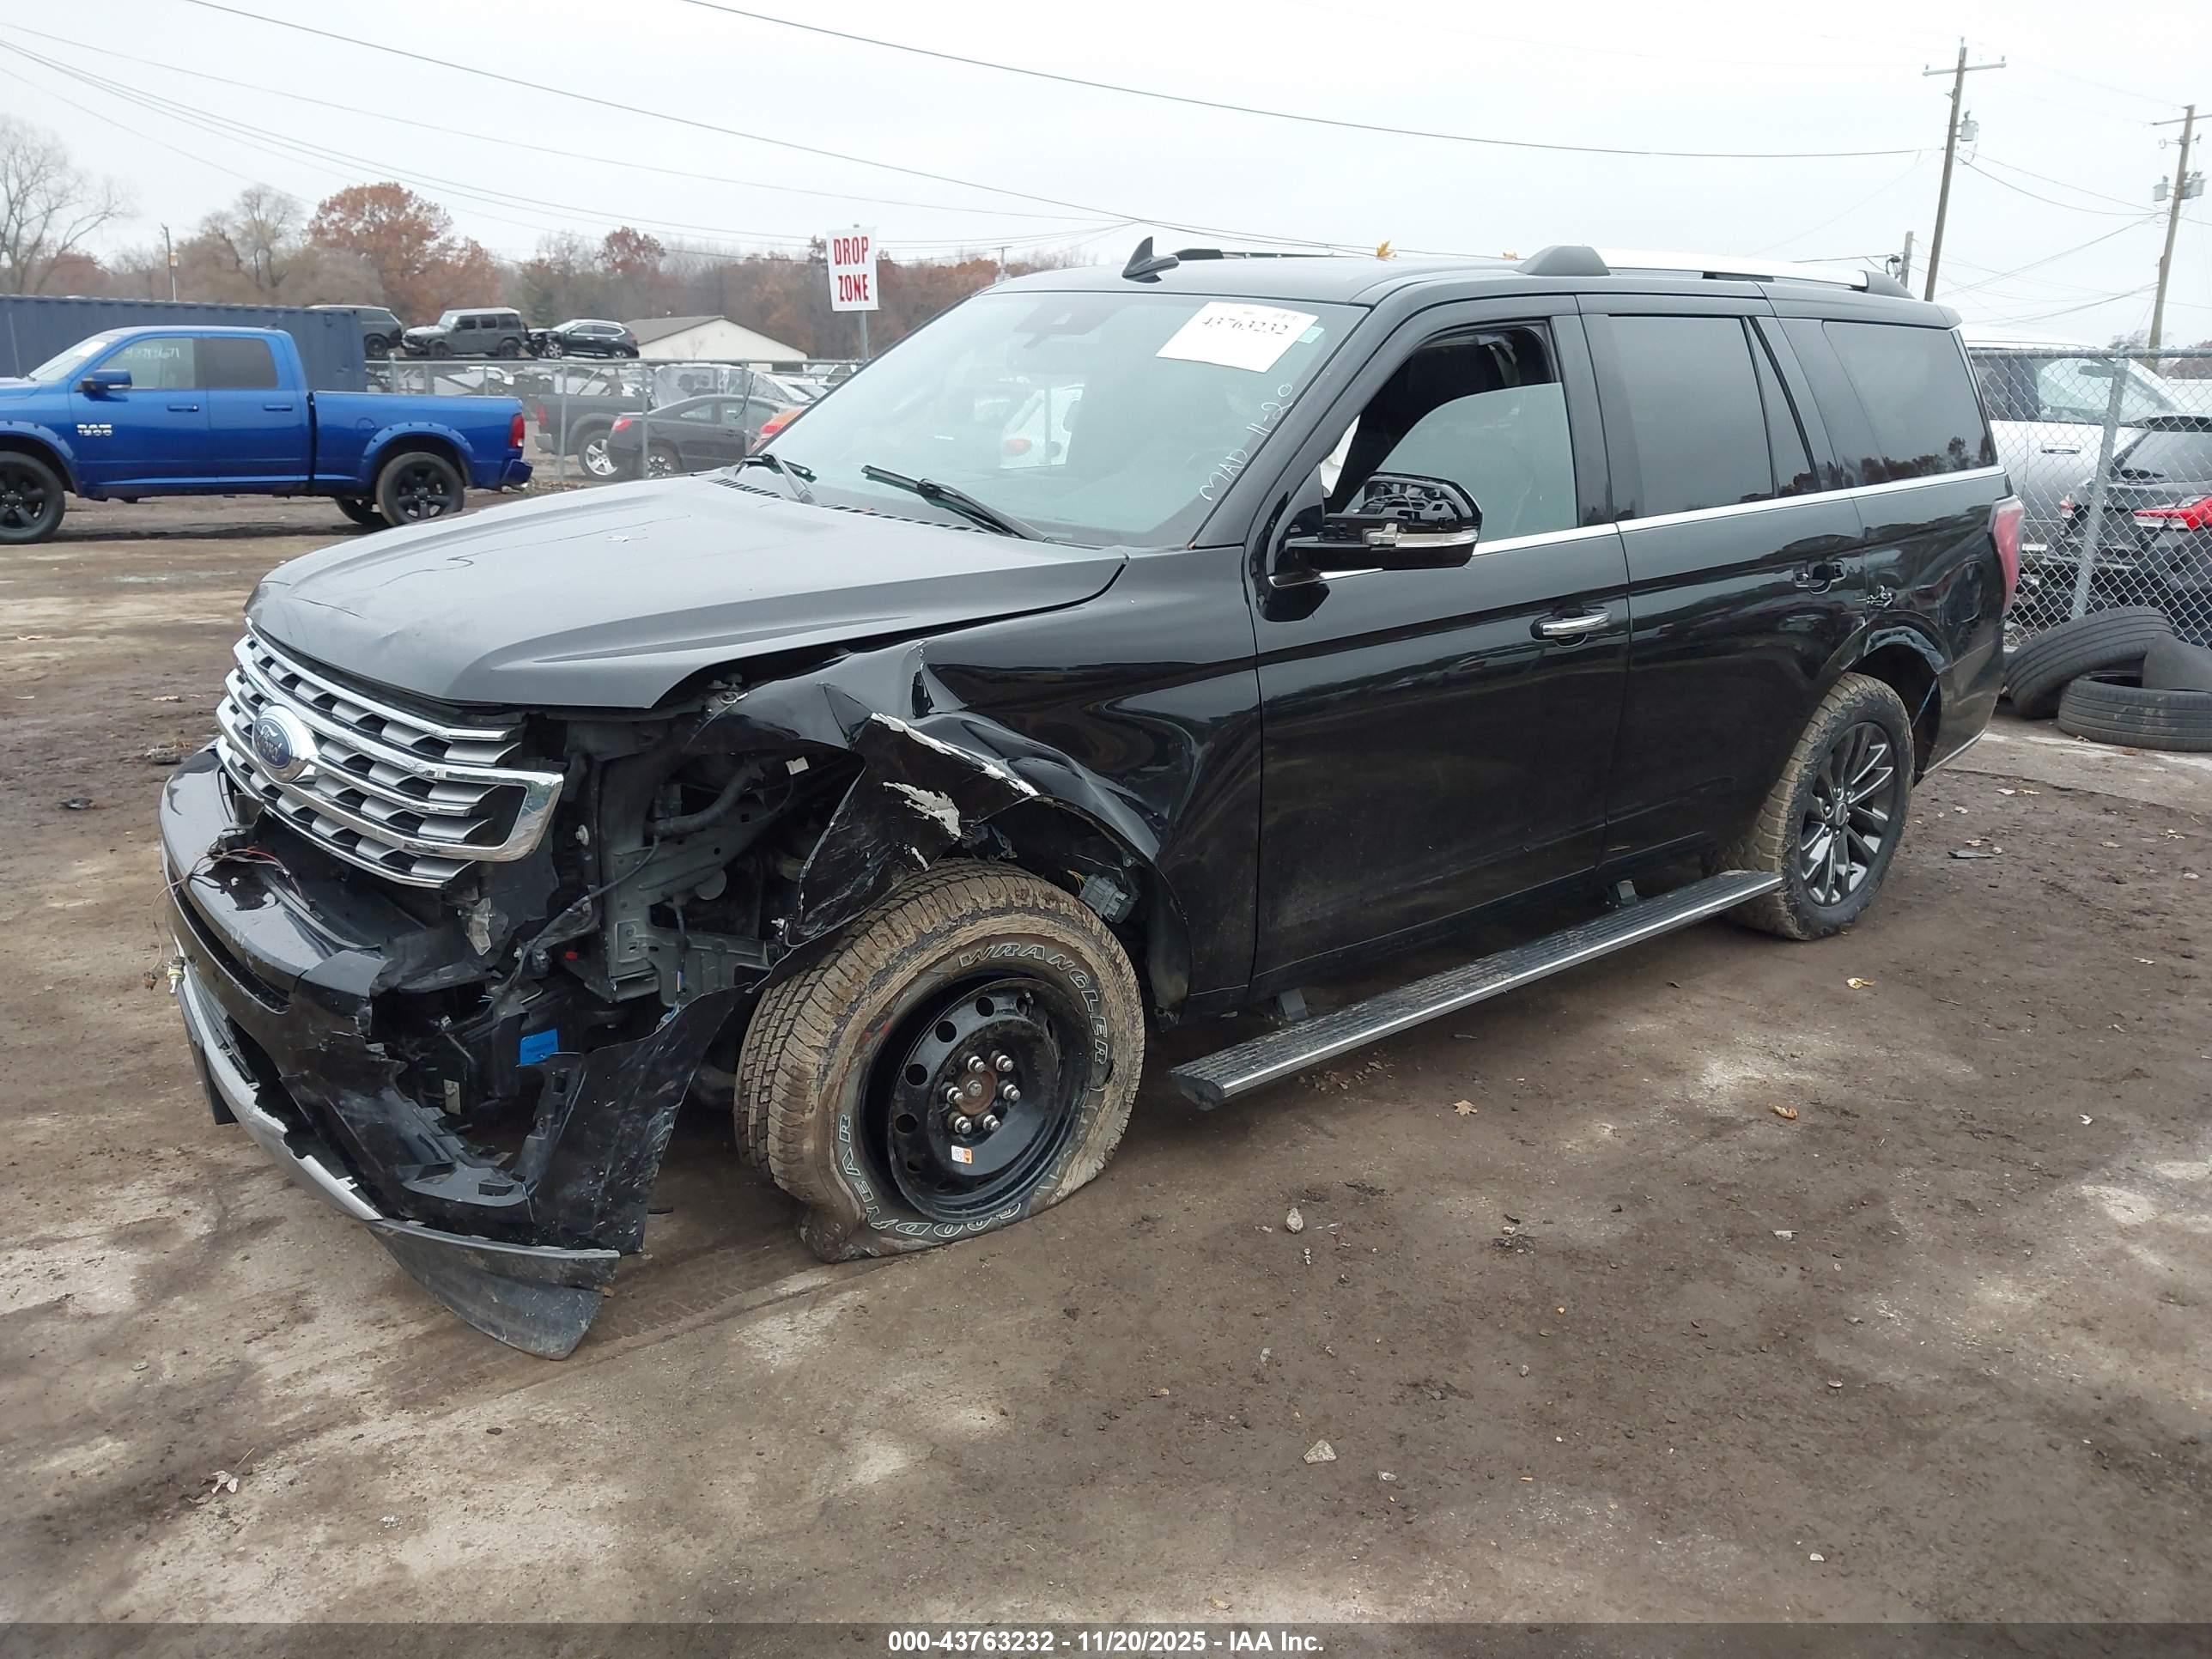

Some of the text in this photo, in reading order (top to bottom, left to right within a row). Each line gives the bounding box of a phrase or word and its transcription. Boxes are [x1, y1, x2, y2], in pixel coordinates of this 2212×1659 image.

[833, 236, 868, 265] DROP
[838, 274, 869, 302] ZONE
[1202, 316, 1289, 336] 43763232
[1200, 383, 1294, 501] MAD 11-20
[258, 725, 283, 763] Ford
[959, 944, 1109, 1065] WRANGLER
[838, 1114, 1022, 1237] GOODYEAR
